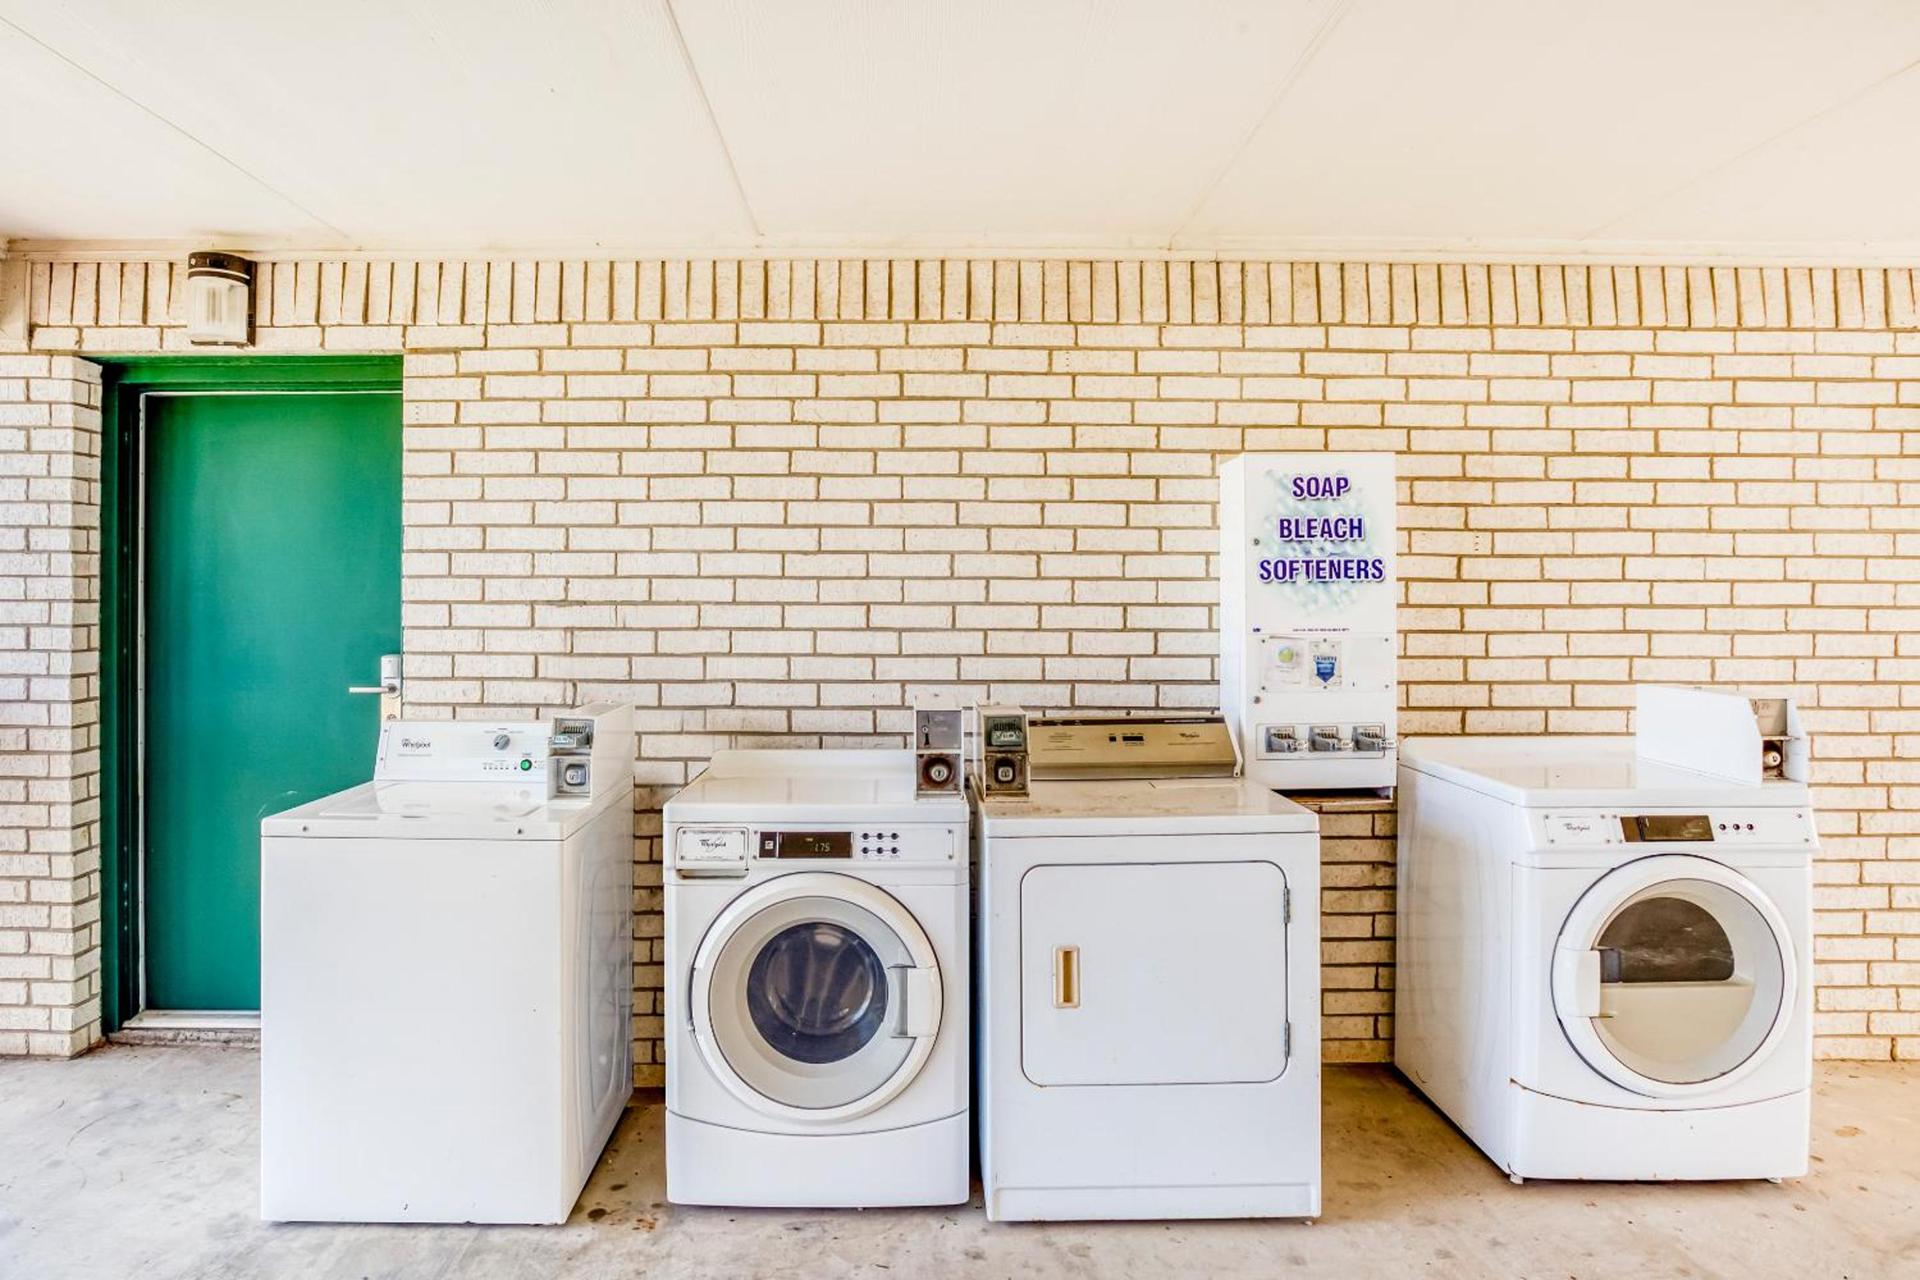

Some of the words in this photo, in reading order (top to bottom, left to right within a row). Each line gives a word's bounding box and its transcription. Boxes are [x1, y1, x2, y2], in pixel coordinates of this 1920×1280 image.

[1291, 476, 1350, 499] SOAP
[1278, 517, 1365, 540] BLEACH
[1258, 558, 1385, 581] SOFTENERS
